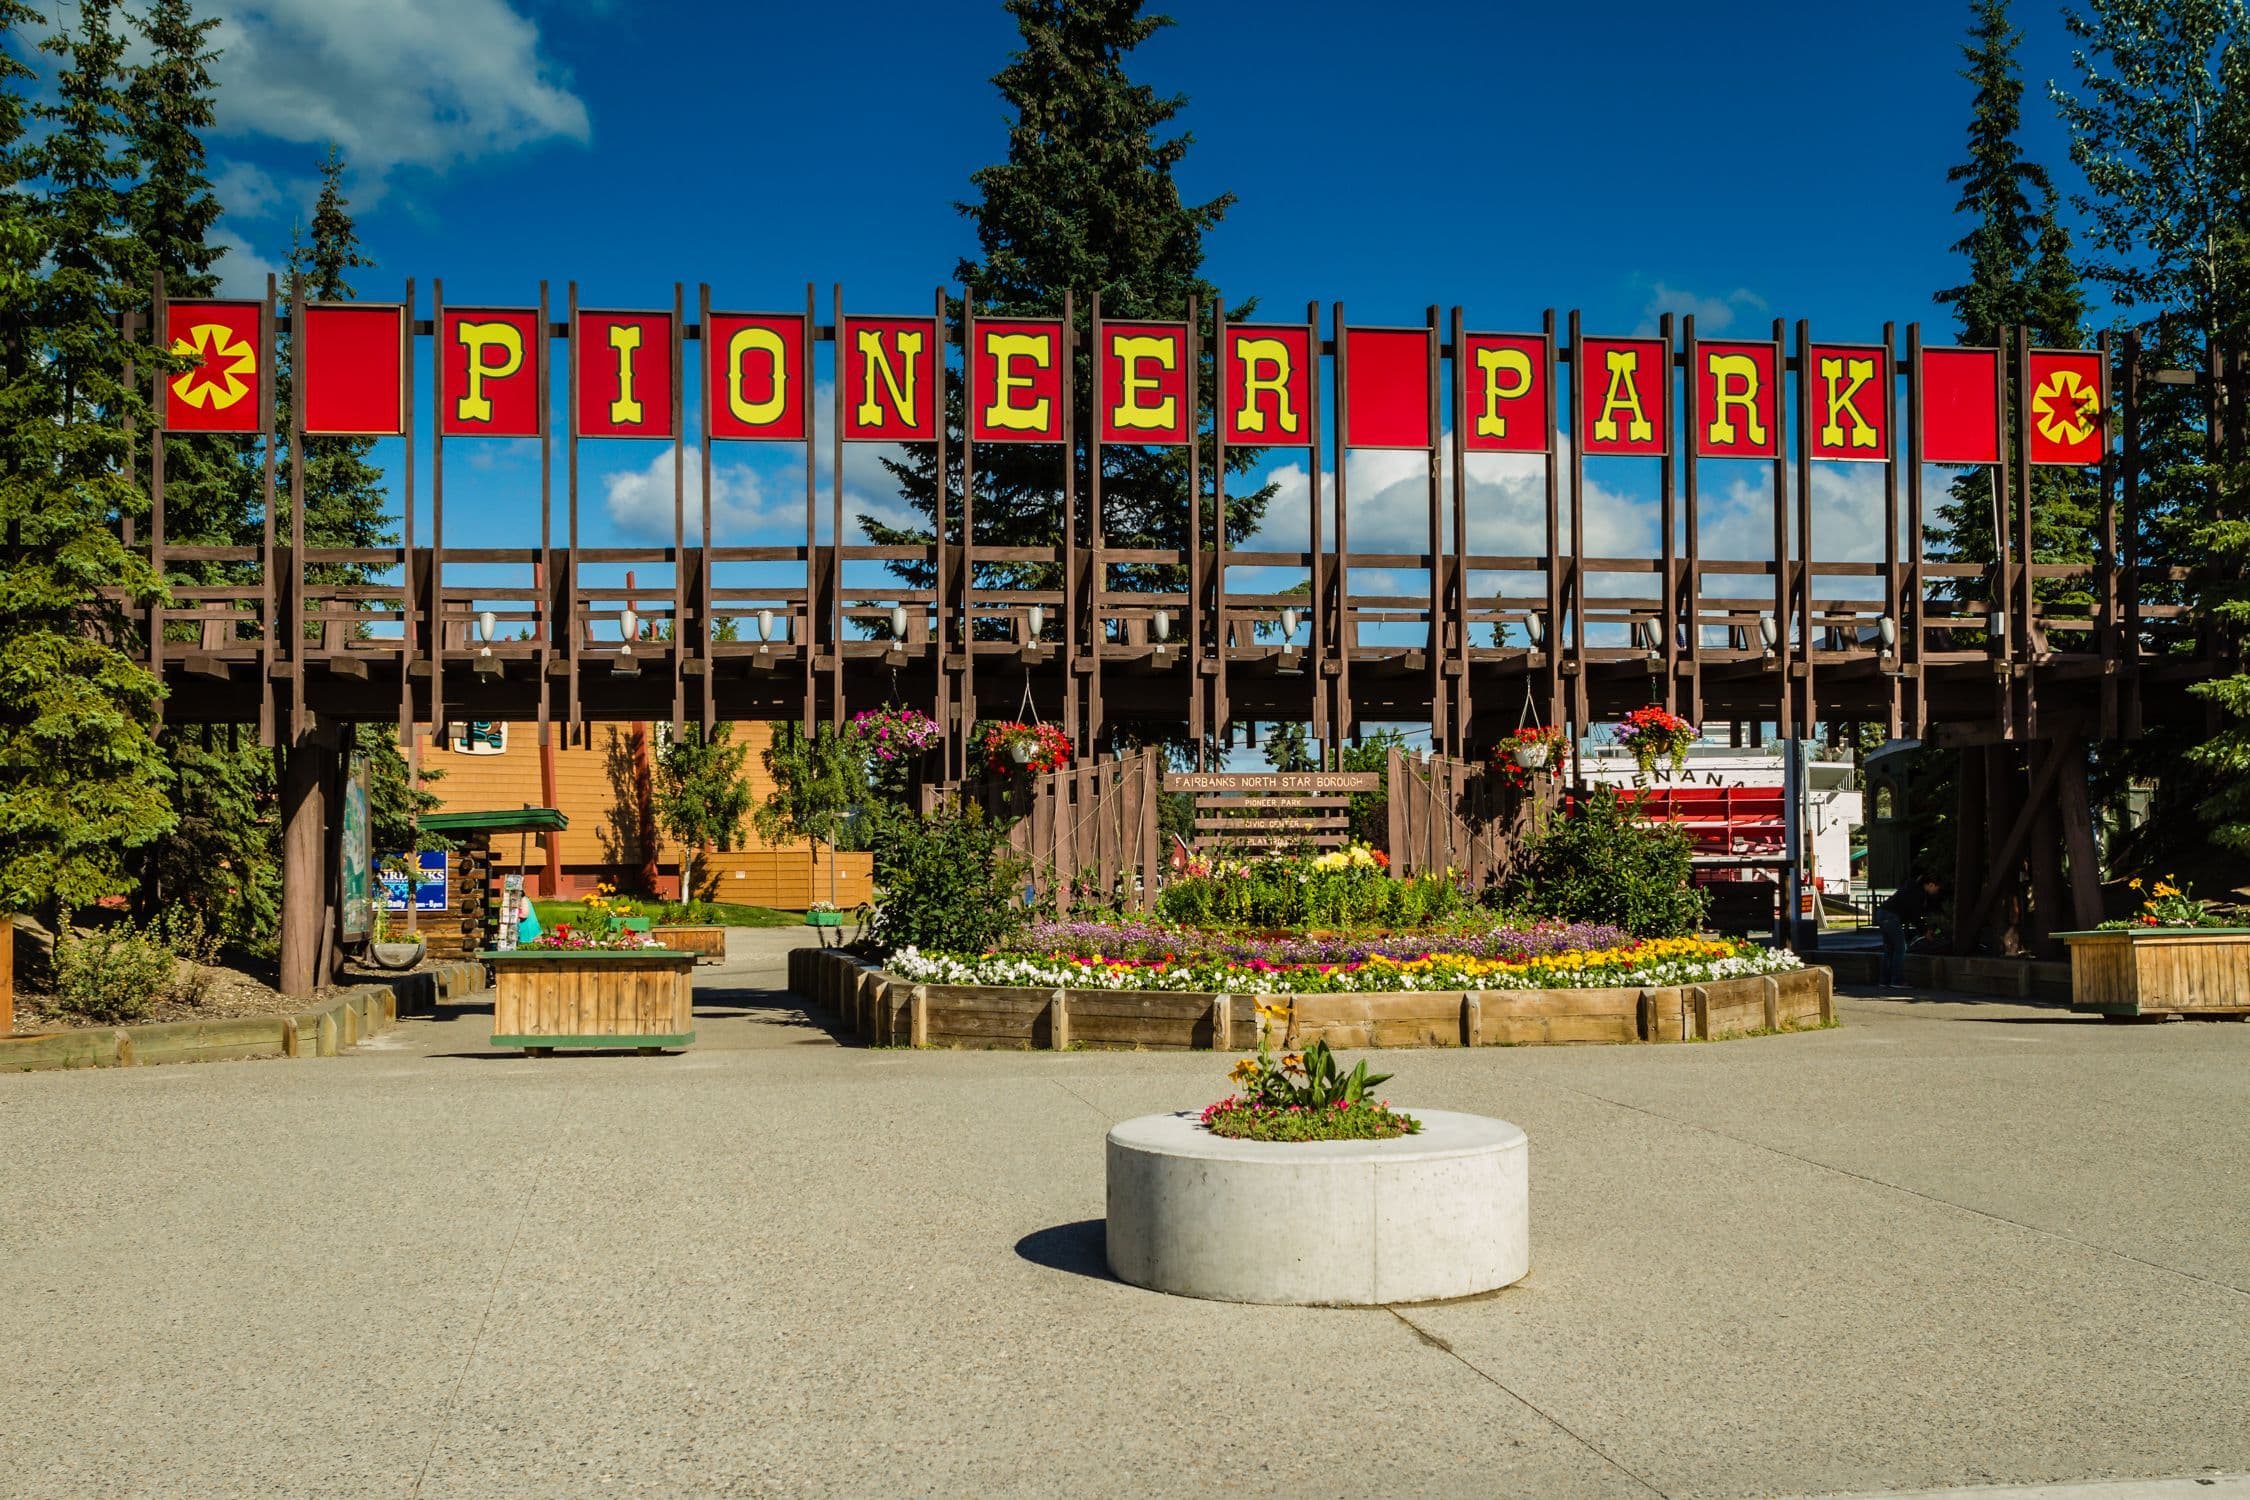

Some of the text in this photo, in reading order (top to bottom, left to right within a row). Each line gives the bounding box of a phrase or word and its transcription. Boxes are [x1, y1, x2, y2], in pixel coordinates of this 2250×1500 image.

[456, 320, 1879, 449] PIONEER PARK
[1175, 777, 1363, 787] FAIRBANKS NORTH STAR BOROUGH
[1245, 799, 1302, 807] PIONEER PARK
[1244, 820, 1299, 828] CIVIC CENTER
